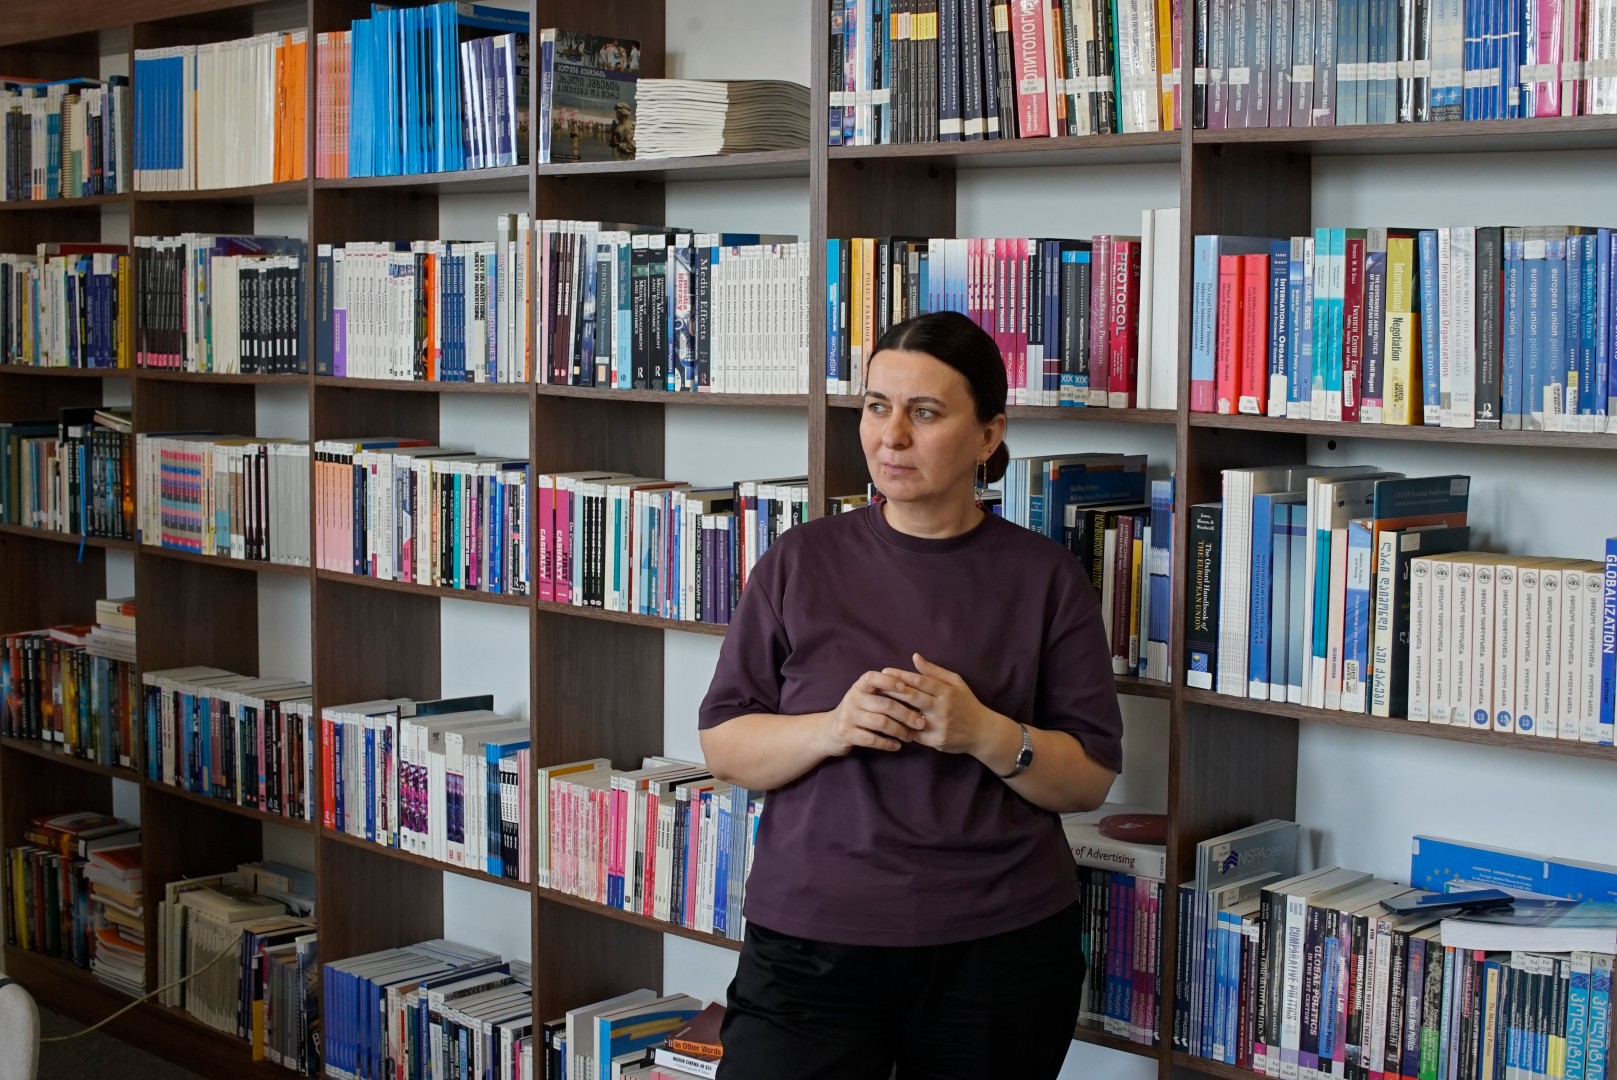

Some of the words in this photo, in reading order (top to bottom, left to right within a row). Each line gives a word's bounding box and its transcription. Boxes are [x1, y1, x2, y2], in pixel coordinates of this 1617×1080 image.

[1021, 0, 1037, 80] ОЛИТОЛОГИ
[1441, 239, 1449, 259] Hurd
[1115, 252, 1127, 336] PROTOCOL
[1279, 278, 1287, 333] INTERNATIONAL
[1393, 263, 1405, 312] International
[1441, 263, 1449, 317] International
[1508, 269, 1516, 309] european
[1529, 269, 1538, 308] european
[1550, 269, 1559, 309] european
[1278, 335, 1286, 375] ORGANIZA
[1390, 317, 1404, 361] Negotiation
[1441, 320, 1450, 377] Organizations
[1508, 338, 1516, 369] politics
[1529, 338, 1538, 369] politics
[1550, 338, 1558, 370] politics
[569, 522, 573, 531] On
[1093, 514, 1103, 556] NEIGHBORHOOD
[1092, 559, 1102, 589] CHALLENGE
[1204, 559, 1212, 583] Oxford
[1379, 542, 1391, 572] ლარი
[1195, 559, 1204, 600] EUROPEAN
[1195, 602, 1203, 630] UNION
[1202, 585, 1210, 620] Handbook
[1377, 578, 1390, 630] დაიმონდი
[1603, 555, 1617, 654] GLOBALIZATION
[1375, 646, 1387, 663] ავი
[1374, 668, 1387, 706] ქარები
[1476, 713, 1484, 721] 13
[1076, 845, 1085, 857] of
[1087, 848, 1135, 868] Advertising
[1238, 845, 1282, 866] NISPAcee
[1287, 926, 1300, 982] COMPARATIVE
[1312, 946, 1322, 987] GLOBAL
[1338, 957, 1346, 995] International
[1355, 955, 1364, 1010] UNDERSTANDING
[1392, 956, 1402, 996] AMERICAN
[1286, 985, 1298, 1020] POLITICS
[1310, 990, 1320, 1036] POLITICS
[1326, 991, 1335, 1030] Comparative
[1409, 996, 1418, 1017] Russia's
[1463, 993, 1472, 1018] society
[1390, 998, 1400, 1047] GOVERNMENT
[1407, 1031, 1415, 1051] Politics
[674, 1040, 681, 1048] In
[682, 1040, 700, 1051] Other
[701, 1045, 722, 1056] Words
